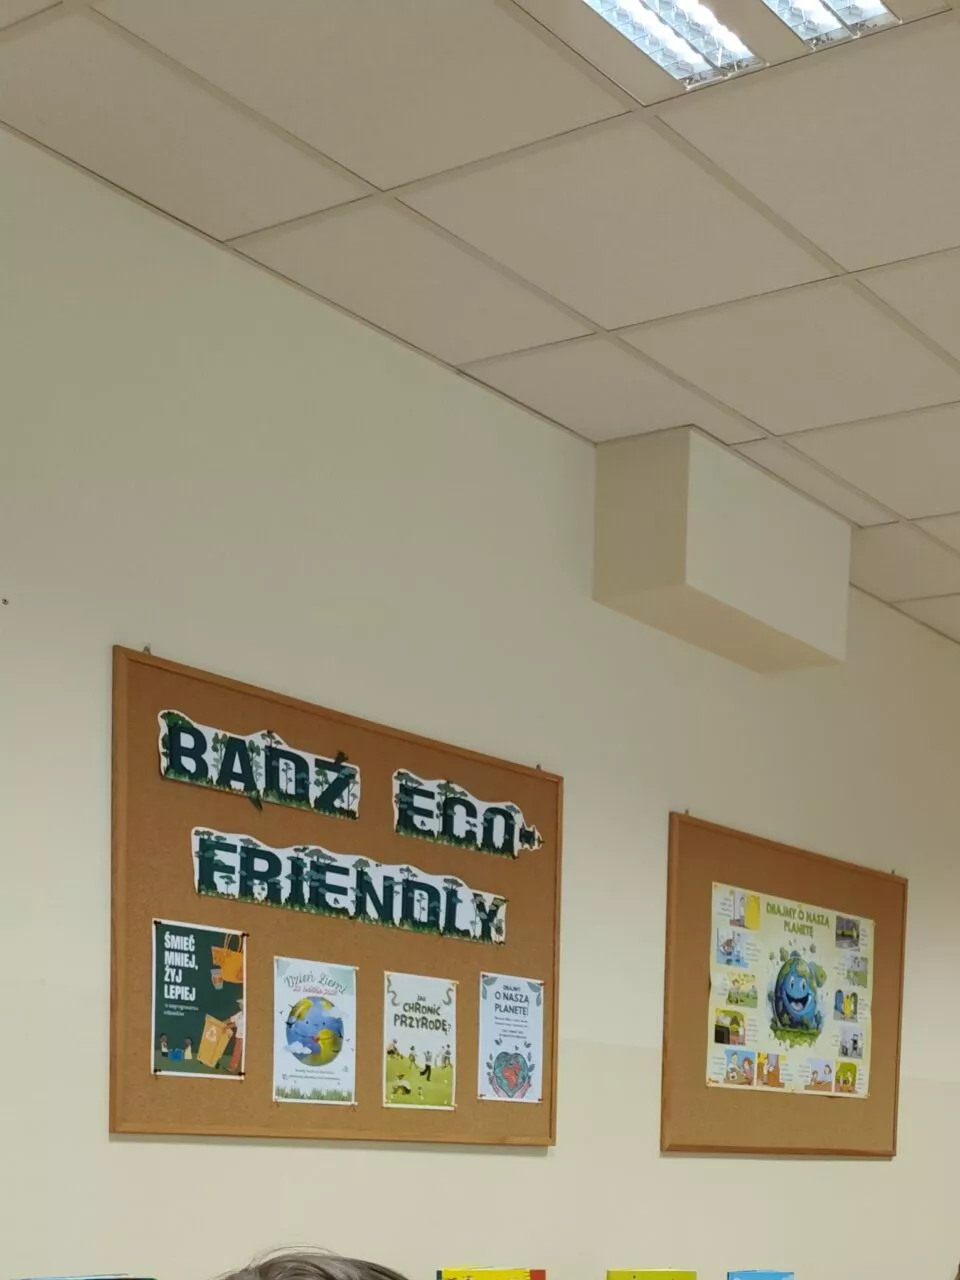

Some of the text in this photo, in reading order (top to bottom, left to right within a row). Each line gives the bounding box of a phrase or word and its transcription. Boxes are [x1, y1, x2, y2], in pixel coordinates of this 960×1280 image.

[195, 829, 507, 945] FRIENDLY
[797, 909, 805, 920] O
[163, 931, 196, 951] ŚMIEĆ
[163, 950, 199, 971] MNIEJ,
[163, 964, 183, 984] ŻYJ
[284, 970, 348, 994] Dzień Ziemi
[163, 983, 196, 1002] LEPIEJ
[494, 991, 502, 1000] O
